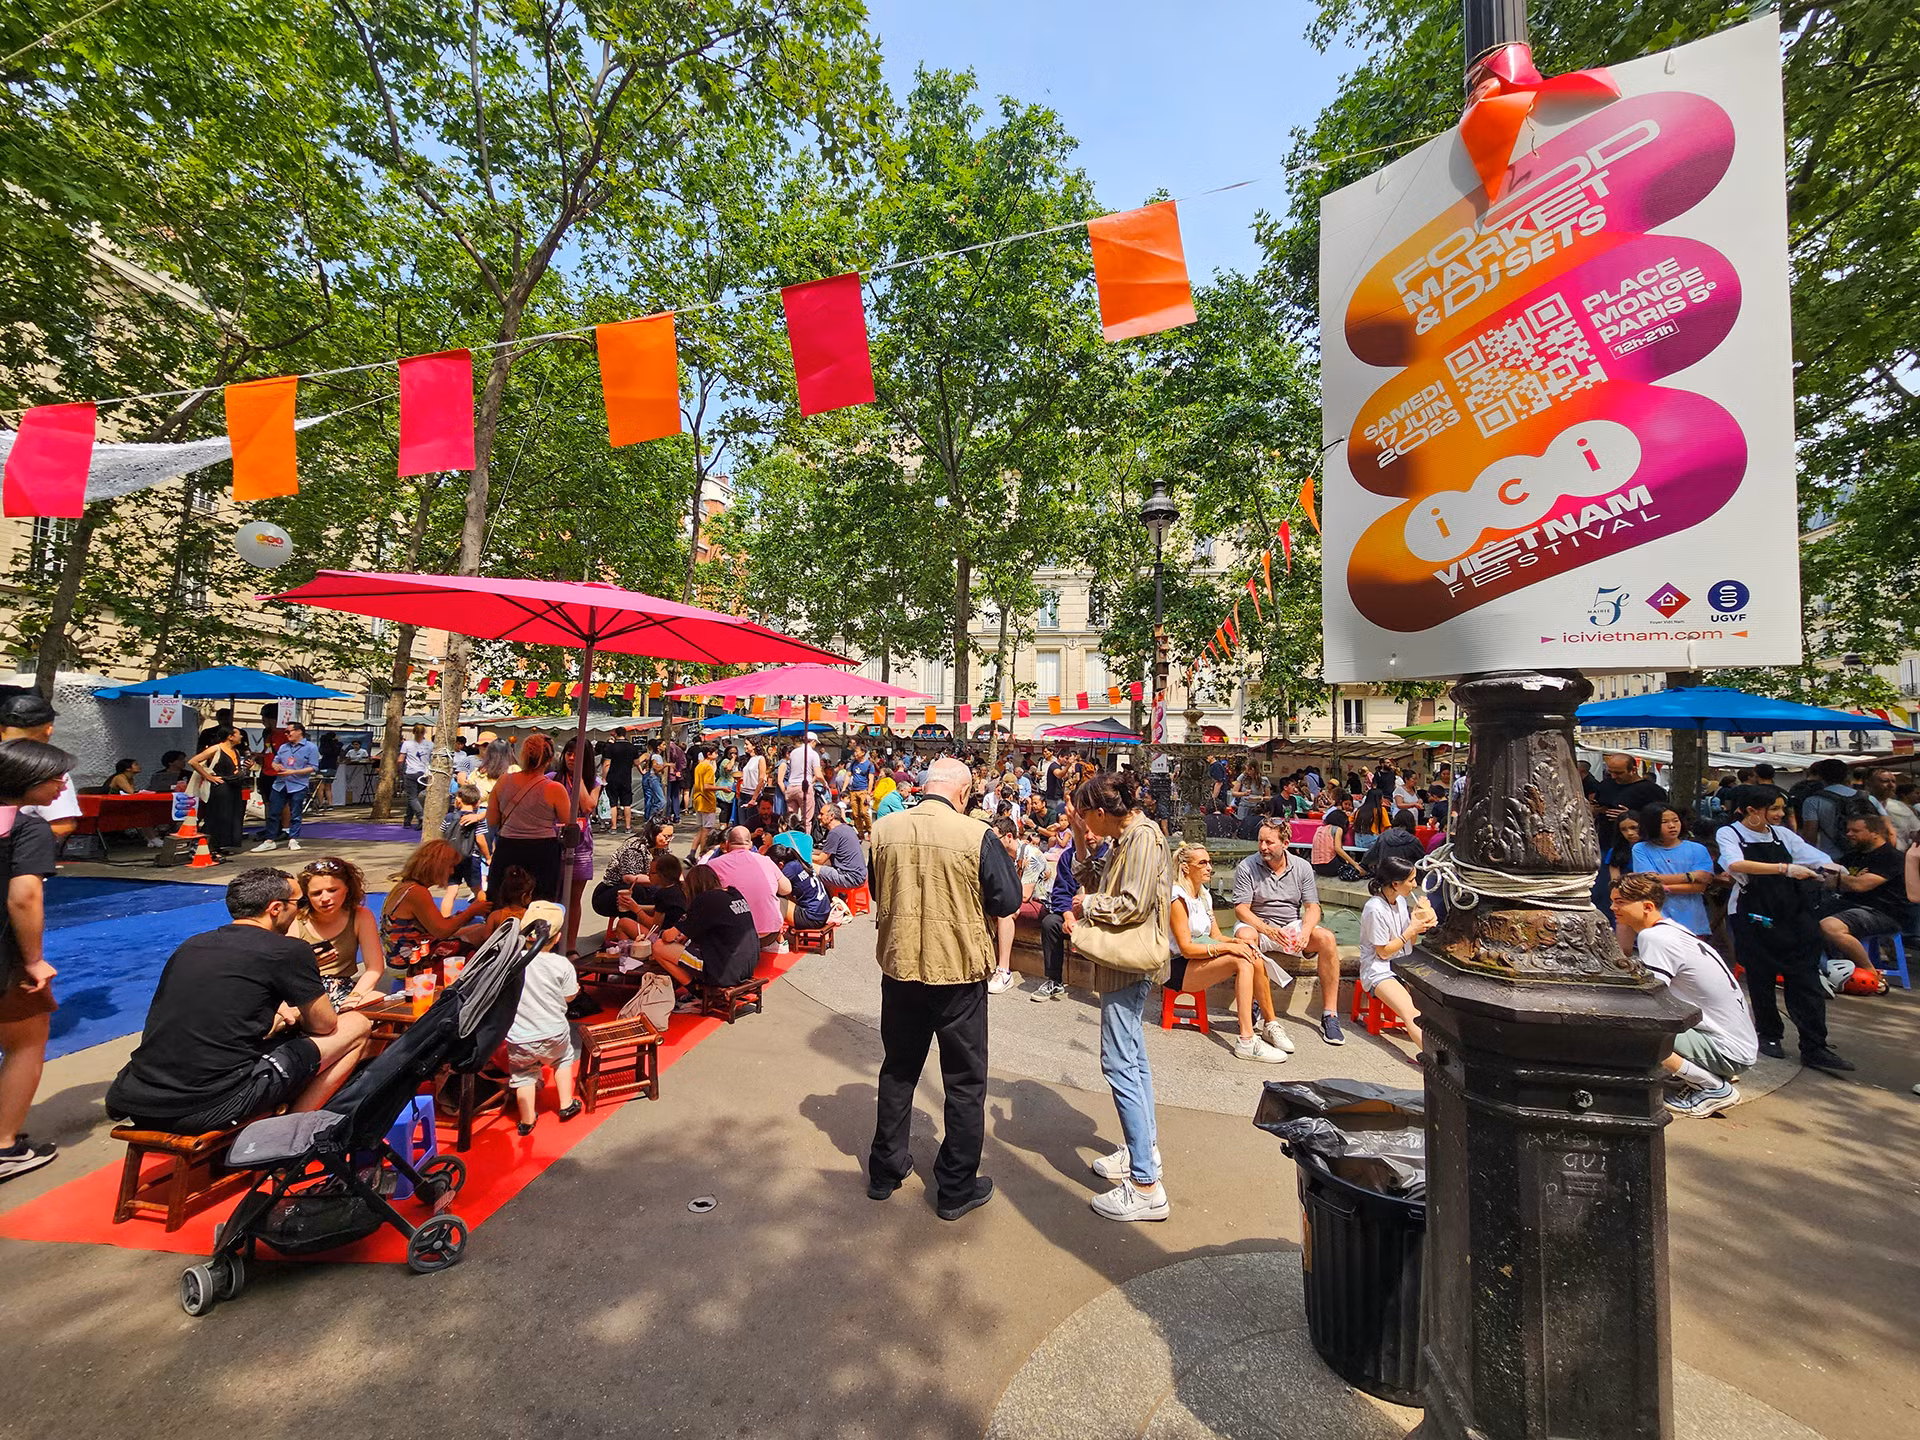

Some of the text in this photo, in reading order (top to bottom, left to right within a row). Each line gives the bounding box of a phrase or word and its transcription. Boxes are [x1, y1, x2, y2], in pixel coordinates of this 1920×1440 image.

[1392, 119, 1661, 294] FOOD
[1402, 170, 1610, 315] MARKET
[1415, 204, 1607, 336] & DJ SETS
[1582, 256, 1681, 313] PLACE
[1590, 266, 1705, 329] MONGE
[1598, 296, 1687, 344] PARIS
[1614, 324, 1675, 355] 12h-21h
[1363, 379, 1446, 441] SAMEDI
[1374, 394, 1454, 450] 17 JUIN
[1376, 409, 1461, 469] 2023
[1448, 510, 1662, 599] FESTIVAL
[1562, 630, 1723, 643] icivietnam.com
[1710, 613, 1748, 623] UGVF
